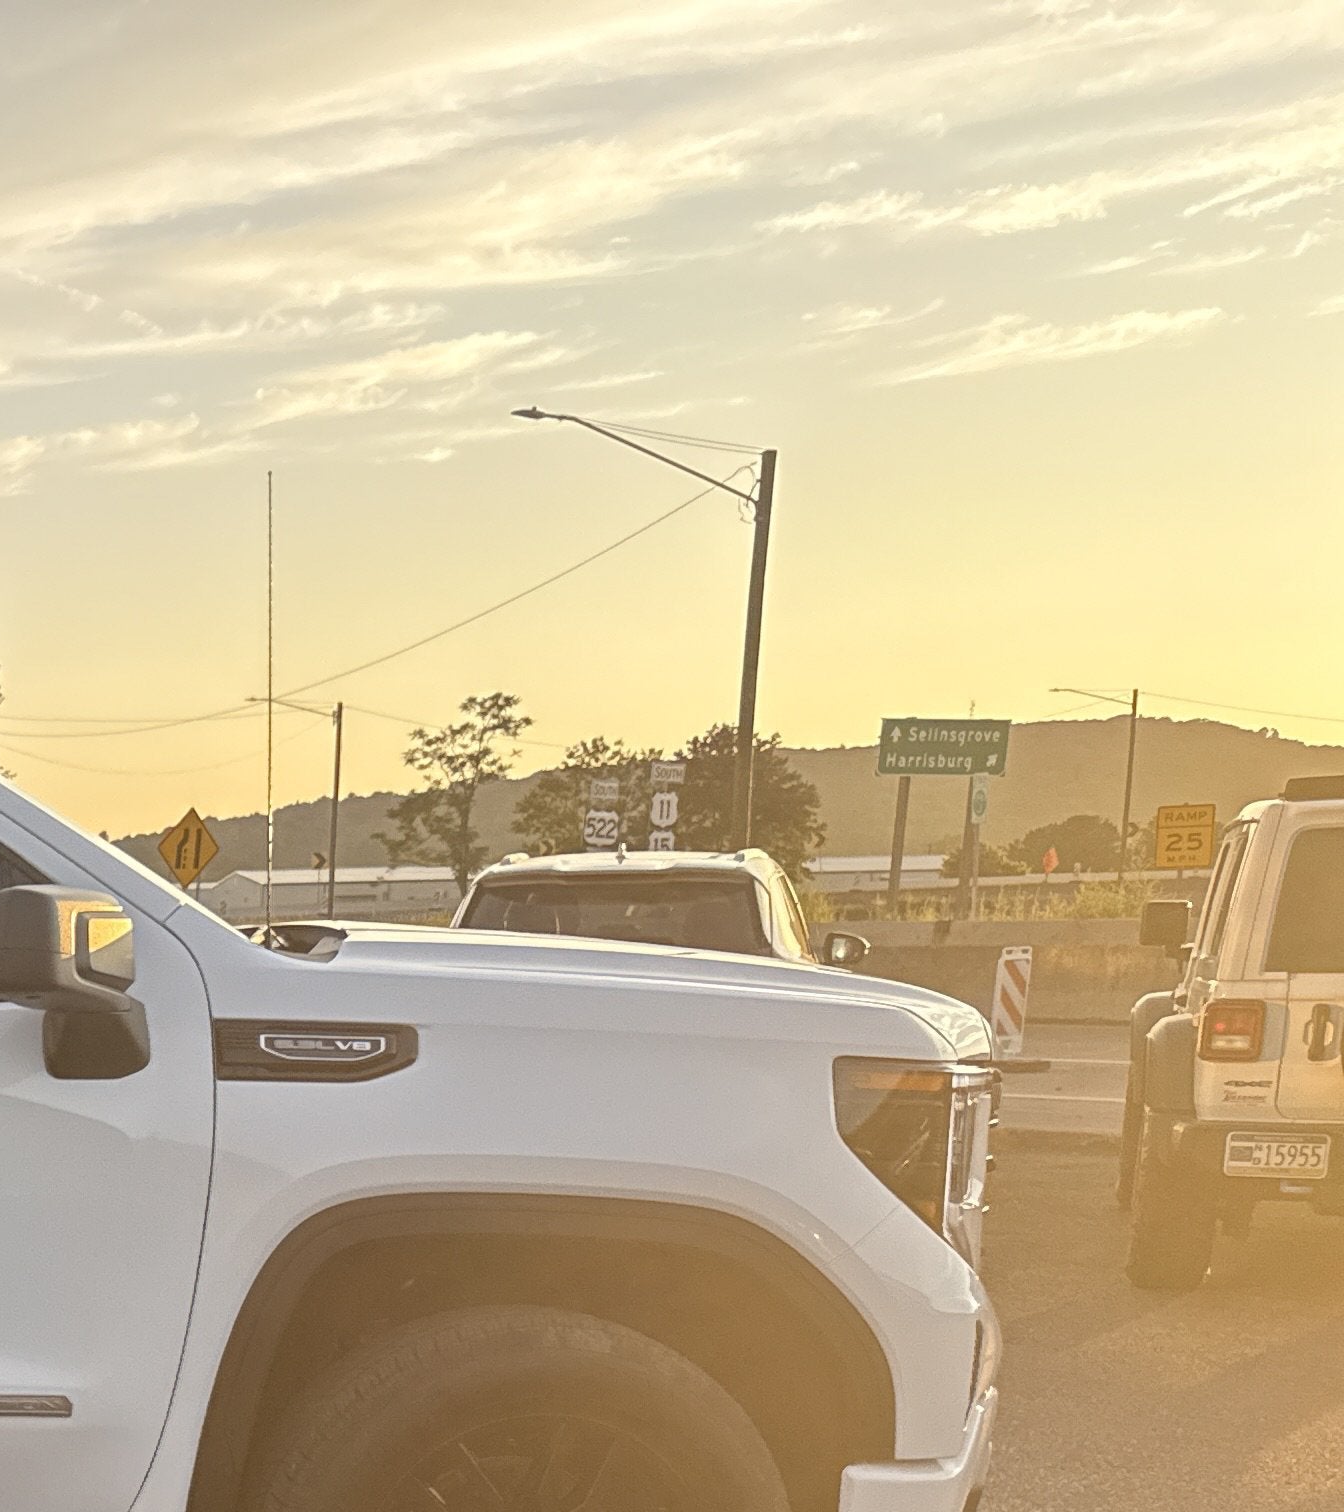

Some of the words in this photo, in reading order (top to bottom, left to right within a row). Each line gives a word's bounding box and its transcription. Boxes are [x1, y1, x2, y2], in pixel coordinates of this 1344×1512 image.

[907, 726, 1001, 747] Selinsgrove
[884, 752, 973, 771] Harrisburg
[654, 765, 684, 779] SOUTH
[659, 799, 671, 820] 11
[1164, 811, 1208, 822] RAMP
[585, 817, 618, 839] 522
[653, 838, 672, 852] 15
[1165, 832, 1203, 852] 25
[1264, 1144, 1322, 1167] 15955
